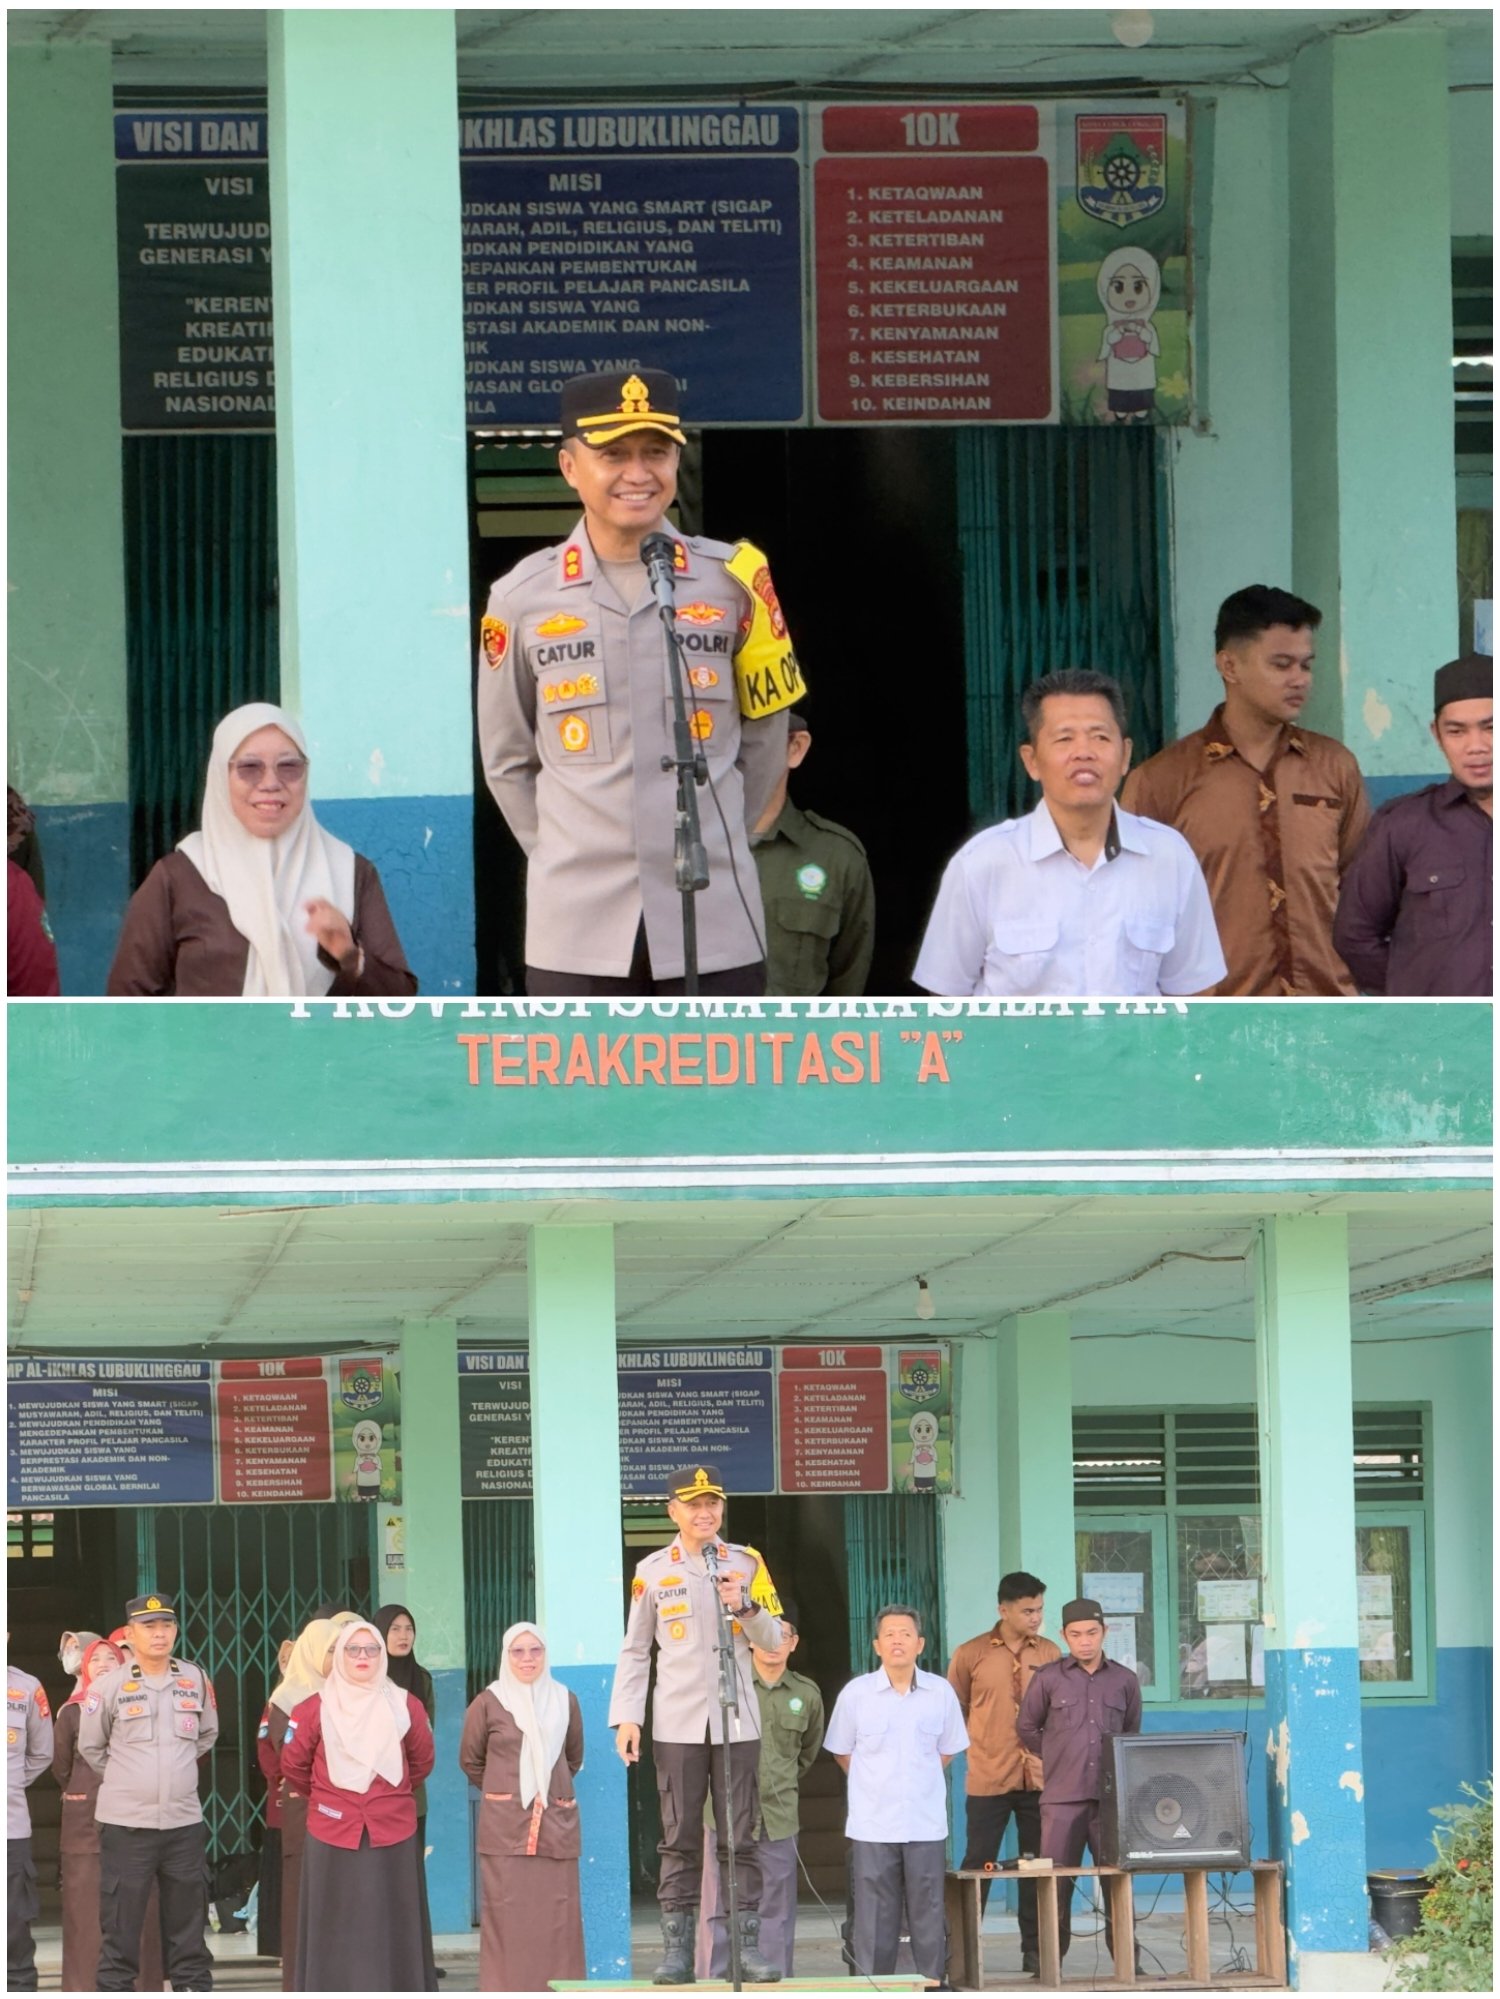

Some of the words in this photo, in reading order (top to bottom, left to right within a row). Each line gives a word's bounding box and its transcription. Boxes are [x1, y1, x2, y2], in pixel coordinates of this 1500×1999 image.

[133, 121, 192, 151] VISI
[200, 120, 259, 150] DAN
[563, 114, 780, 147] LUBUKLINGGAU
[901, 112, 960, 146] 10K
[205, 177, 253, 195] VISI
[549, 173, 602, 192] MISI
[847, 188, 863, 200] 1.
[868, 186, 983, 202] KETAQWAAN
[527, 201, 584, 216] SISWA
[590, 201, 639, 215] YANG
[643, 200, 706, 214] SMART
[712, 199, 772, 216] (SIGAP
[846, 210, 863, 223] 2.
[868, 209, 1003, 224] KETELADANAN
[530, 222, 578, 238] ADIL,
[583, 220, 673, 236] RELIGIUS,
[678, 220, 715, 234] DAN
[721, 219, 782, 235] TELITI)
[527, 240, 639, 255] PENDIDIKAN
[645, 239, 694, 254] YANG
[847, 234, 863, 247] 3.
[869, 233, 984, 247] KETERTIBAN
[140, 247, 253, 265] GENERASI
[560, 260, 697, 275] PEMBENTUKAN
[847, 257, 863, 270] 4.
[870, 257, 973, 271] KEAMANAN
[495, 281, 559, 296] PROFIL
[564, 279, 644, 295] PELAJAR
[650, 278, 750, 293] PANCASILA
[848, 281, 864, 294] 5.
[870, 280, 1018, 295] KEKELUARGAAN
[185, 297, 272, 314] "KEREN
[528, 300, 586, 315] SISWA
[591, 300, 640, 314] YANG
[848, 304, 865, 317] 6.
[870, 303, 1007, 318] KETERBUKAAN
[522, 320, 617, 335] AKADEMIK
[622, 319, 660, 333] DAN
[665, 319, 711, 333] NON-
[849, 328, 865, 341] 7.
[871, 327, 999, 341] KENYAMANAN
[849, 351, 865, 364] 8.
[871, 350, 980, 365] KESEHATAN
[530, 360, 587, 375] SISWA
[592, 359, 641, 373] YANG
[154, 371, 259, 388] RELIGIUS
[528, 379, 563, 394] GLO
[849, 374, 866, 388] 9.
[871, 373, 990, 388] KEBERSIHAN
[851, 398, 877, 411] 10.
[883, 397, 991, 411] KEINDAHAN
[537, 640, 595, 666] CATUR
[746, 666, 781, 710] KA
[456, 1032, 881, 1086] TERAKREDITASI
[466, 1355, 494, 1370] VISI
[497, 1355, 524, 1370] DAN
[663, 1351, 763, 1367] LUBUKLINGGAU
[818, 1350, 846, 1366] 10K
[26, 1362, 96, 1377] AL-IKHLAS
[99, 1363, 202, 1377] LUBUKLINGGAU
[258, 1362, 286, 1376] 10K
[499, 1381, 522, 1390] VISI
[657, 1378, 681, 1387] MISI
[93, 1388, 118, 1397] MISI
[18, 1402, 80, 1410] MEWUJUDKAN
[19, 1411, 82, 1419] MUSYAWARAH,
[84, 1410, 106, 1418] ADIL,
[469, 1413, 522, 1422] GENERASI
[19, 1420, 80, 1428] MEWUJUDKAN
[83, 1419, 136, 1427] PENDIDIKAN
[19, 1429, 96, 1437] MENGEDEPANKAN
[99, 1428, 163, 1436] PEMBENTUKAN
[20, 1438, 65, 1446] KARAKTER
[20, 1448, 82, 1456] MEWUJUDKAN
[21, 1466, 65, 1474] AKADEMIK
[476, 1470, 524, 1478] RELIGIUS
[21, 1484, 82, 1492] BERWAWASAN
[658, 1588, 687, 1600] CATUR
[173, 1690, 198, 1699] POLRI
